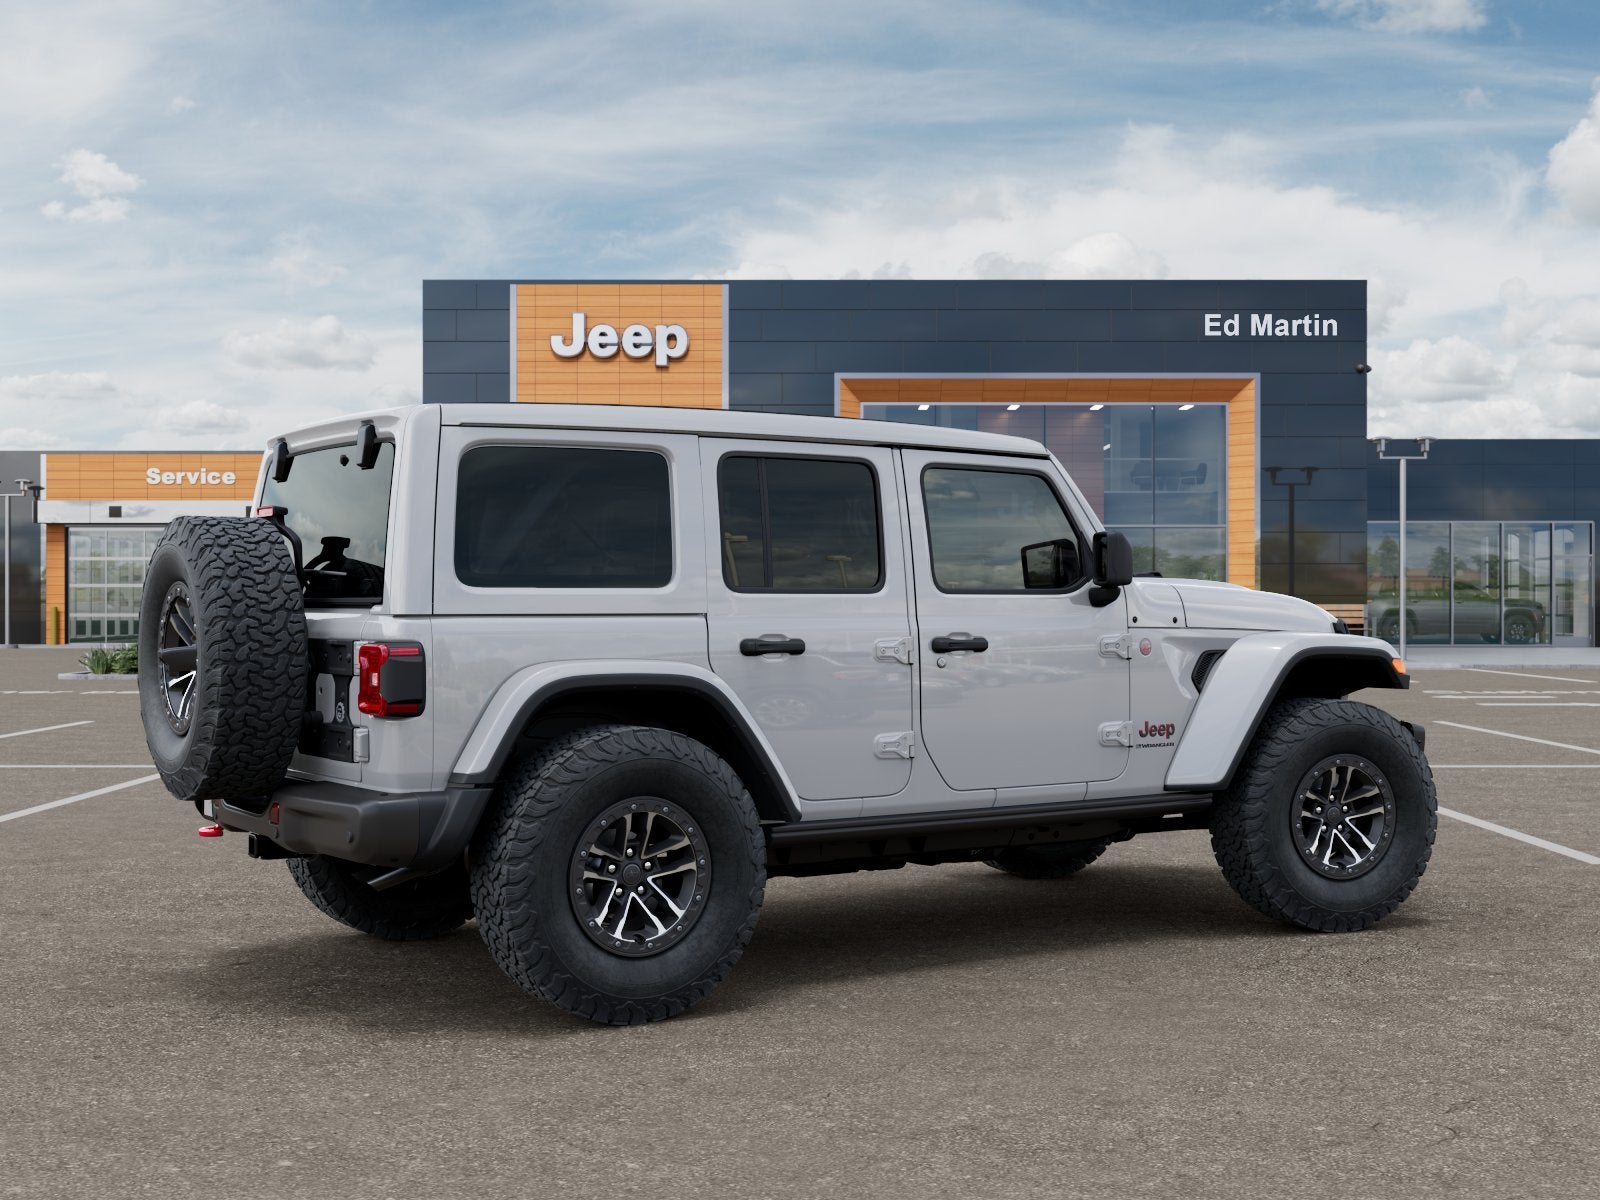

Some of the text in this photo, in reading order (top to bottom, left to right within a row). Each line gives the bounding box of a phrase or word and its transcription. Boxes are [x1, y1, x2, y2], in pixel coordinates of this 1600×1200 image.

[1204, 313, 1338, 337] Ed Martin
[550, 311, 689, 368] Jeep
[146, 467, 237, 485] Service
[1138, 720, 1176, 740] Jeep
